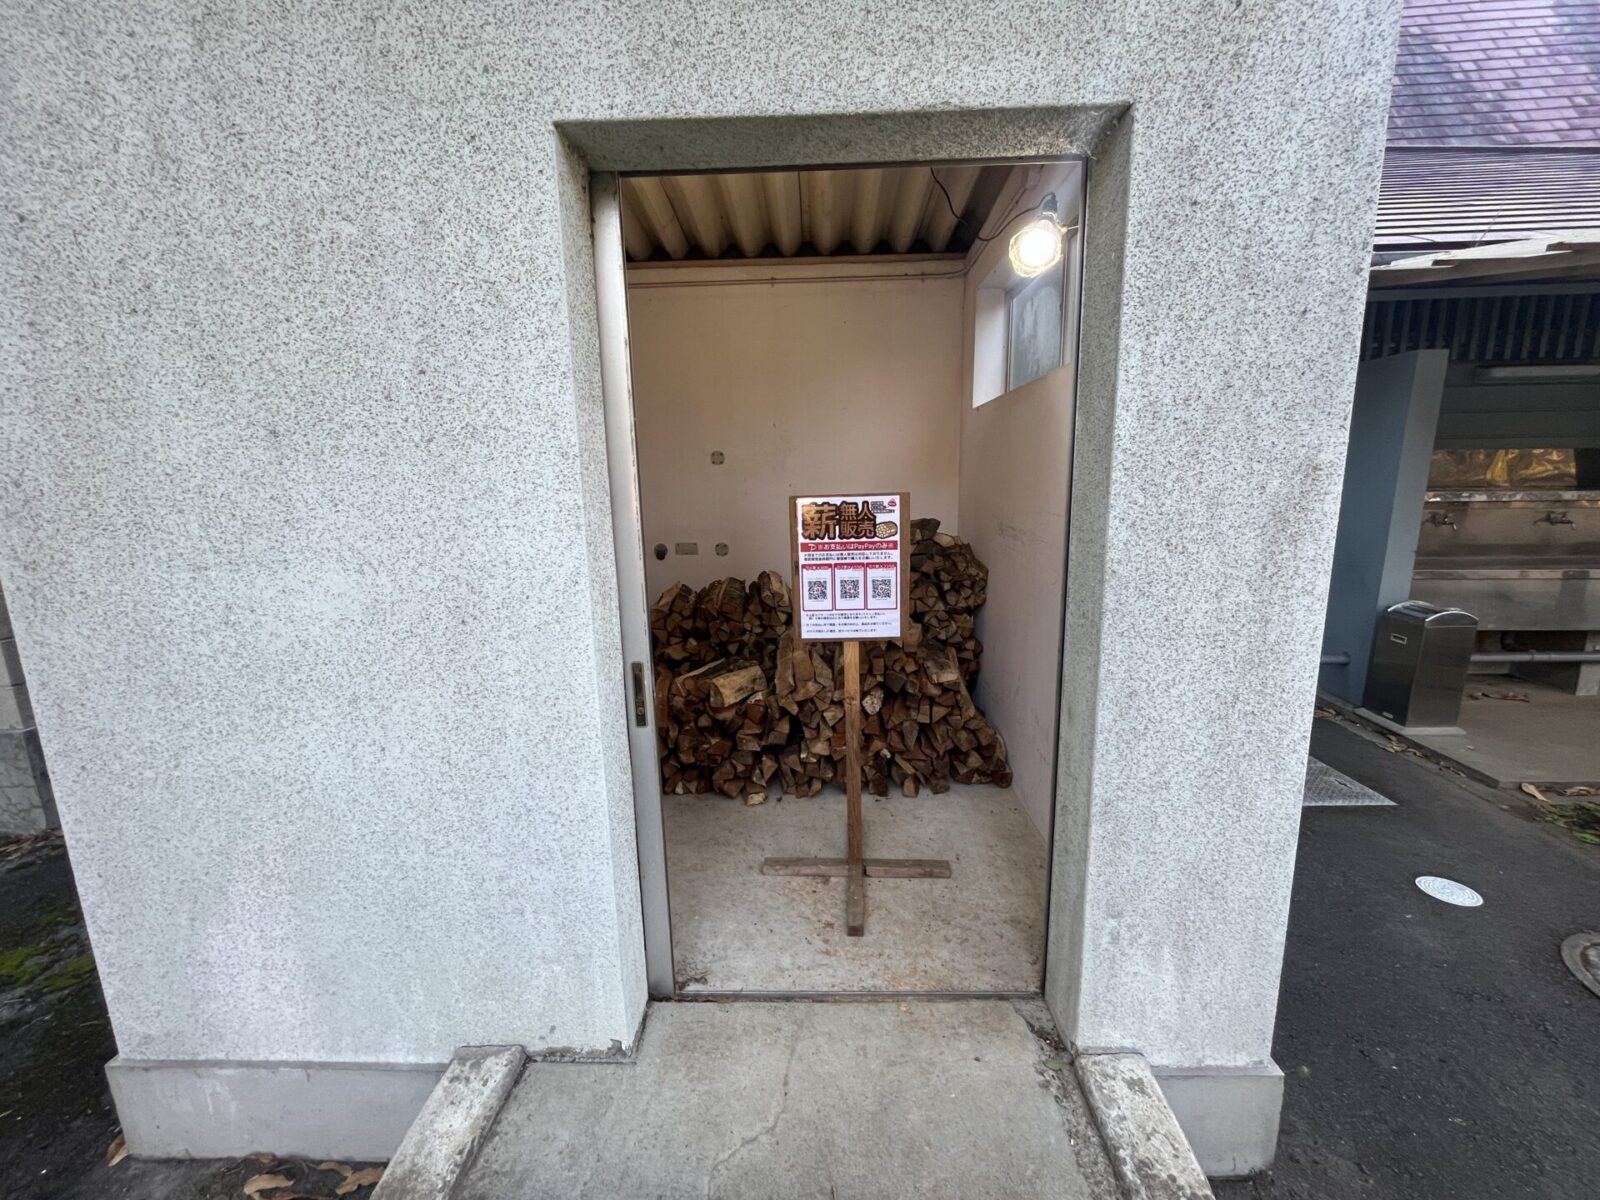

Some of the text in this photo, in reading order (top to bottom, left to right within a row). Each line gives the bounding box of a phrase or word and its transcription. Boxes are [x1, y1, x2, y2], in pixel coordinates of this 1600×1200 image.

[840, 502, 876, 520] 無人
[802, 502, 838, 539] 薪
[840, 520, 876, 538] 販売
